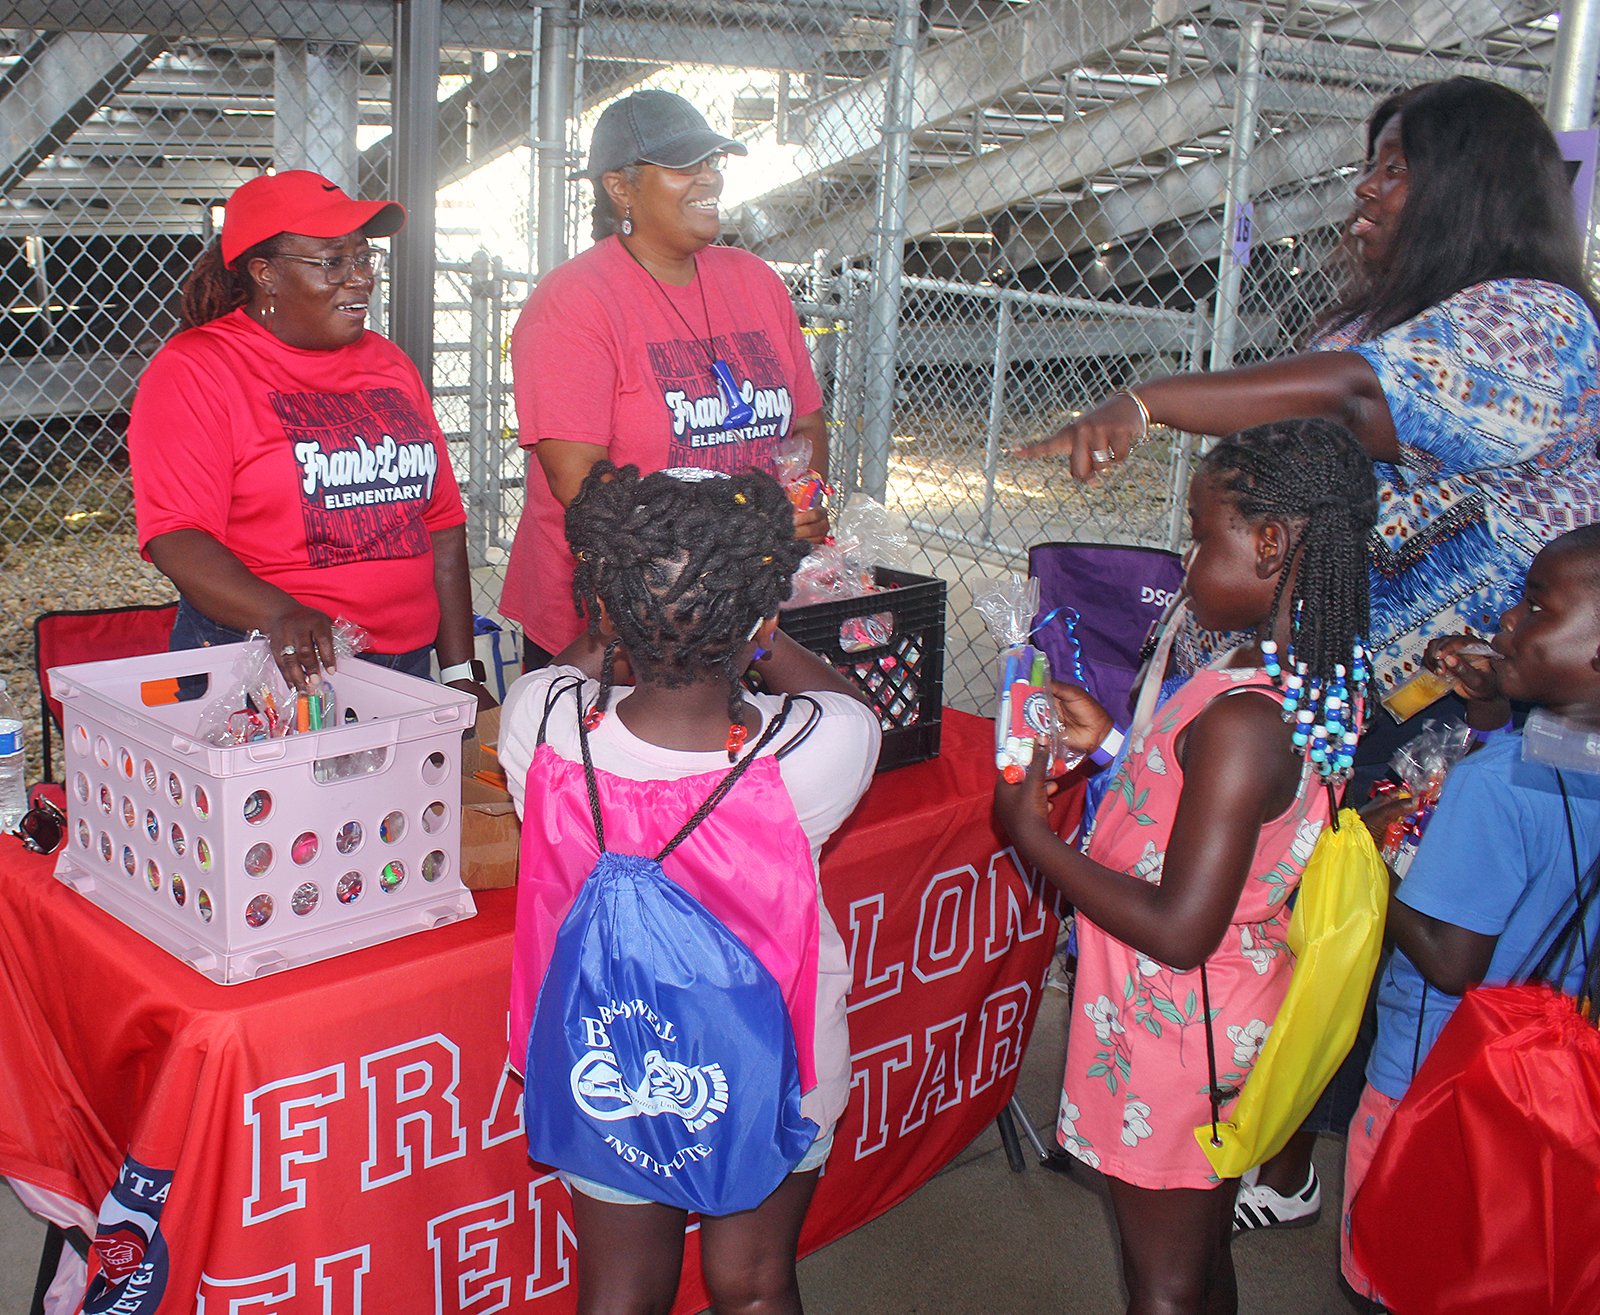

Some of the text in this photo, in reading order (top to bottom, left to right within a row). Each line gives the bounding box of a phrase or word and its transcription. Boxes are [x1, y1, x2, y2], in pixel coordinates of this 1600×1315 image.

[665, 383, 731, 435] Fran
[691, 423, 778, 448] ELEMENTARY
[295, 435, 437, 500] Frank Long
[324, 484, 423, 510] ELEMENTARY
[847, 838, 1062, 1012] LON
[850, 978, 1048, 1162] TAR
[603, 1133, 714, 1178] INSTITUTE
